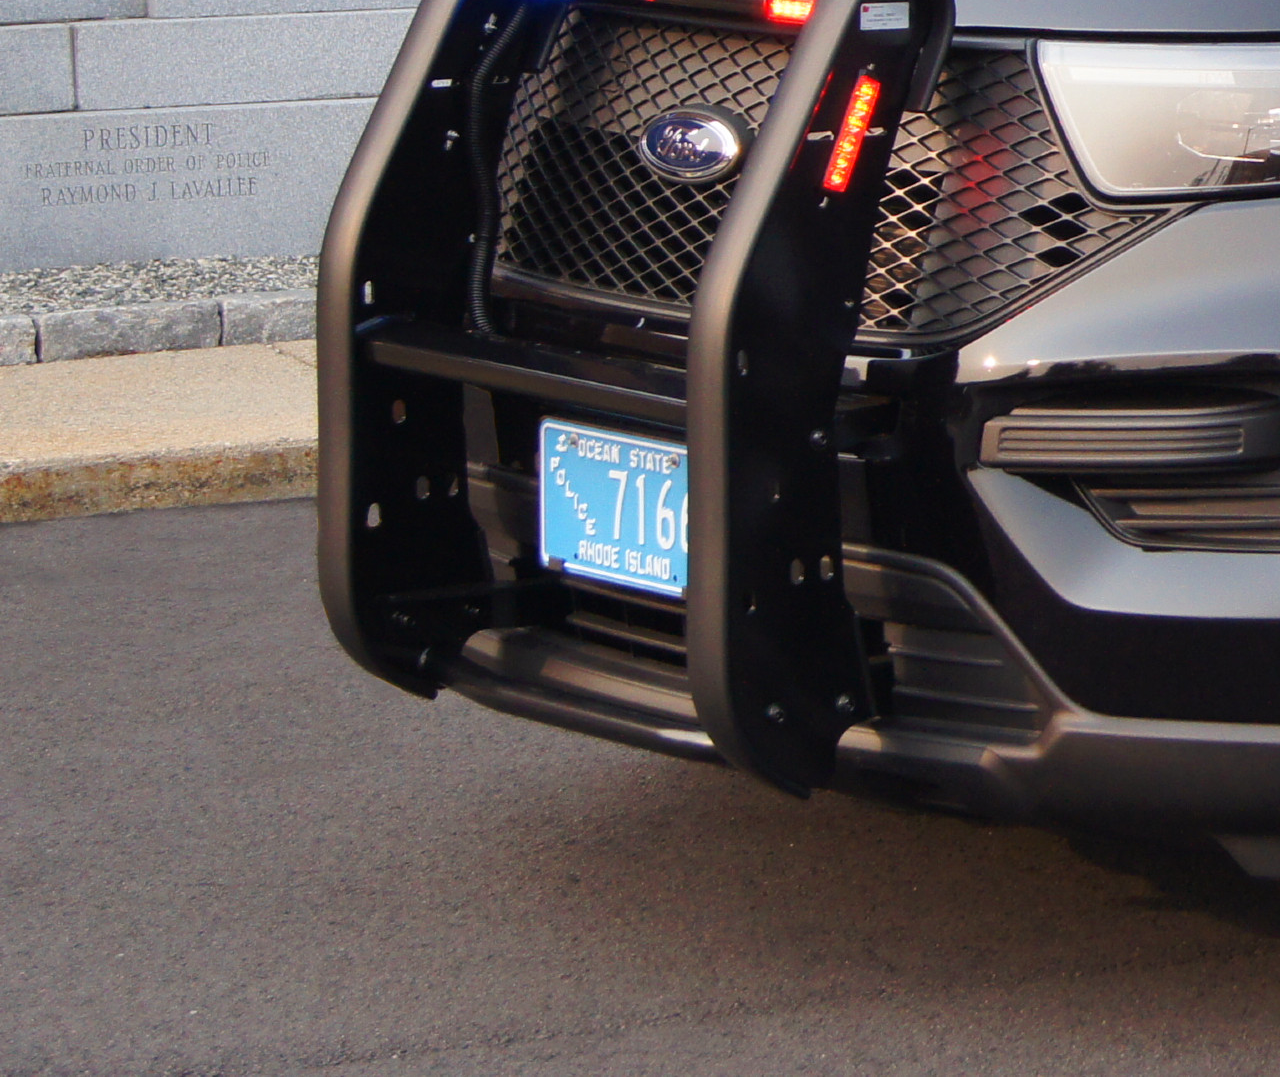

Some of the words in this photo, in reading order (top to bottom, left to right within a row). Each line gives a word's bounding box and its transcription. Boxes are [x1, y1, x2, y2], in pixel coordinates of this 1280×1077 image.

[83, 123, 213, 151] PRESIDENT
[25, 160, 115, 179] FRATERNAL
[124, 156, 176, 173] ORDER
[186, 155, 205, 171] OF
[217, 151, 270, 169] POLICE
[41, 184, 136, 206] RAYMOND
[171, 177, 257, 199] LAVALLEE
[579, 437, 620, 464] OCEAN
[630, 448, 673, 474] STATE
[550, 456, 596, 536] POLICE
[579, 540, 620, 569] RHODE
[625, 549, 671, 581] ISLAND
